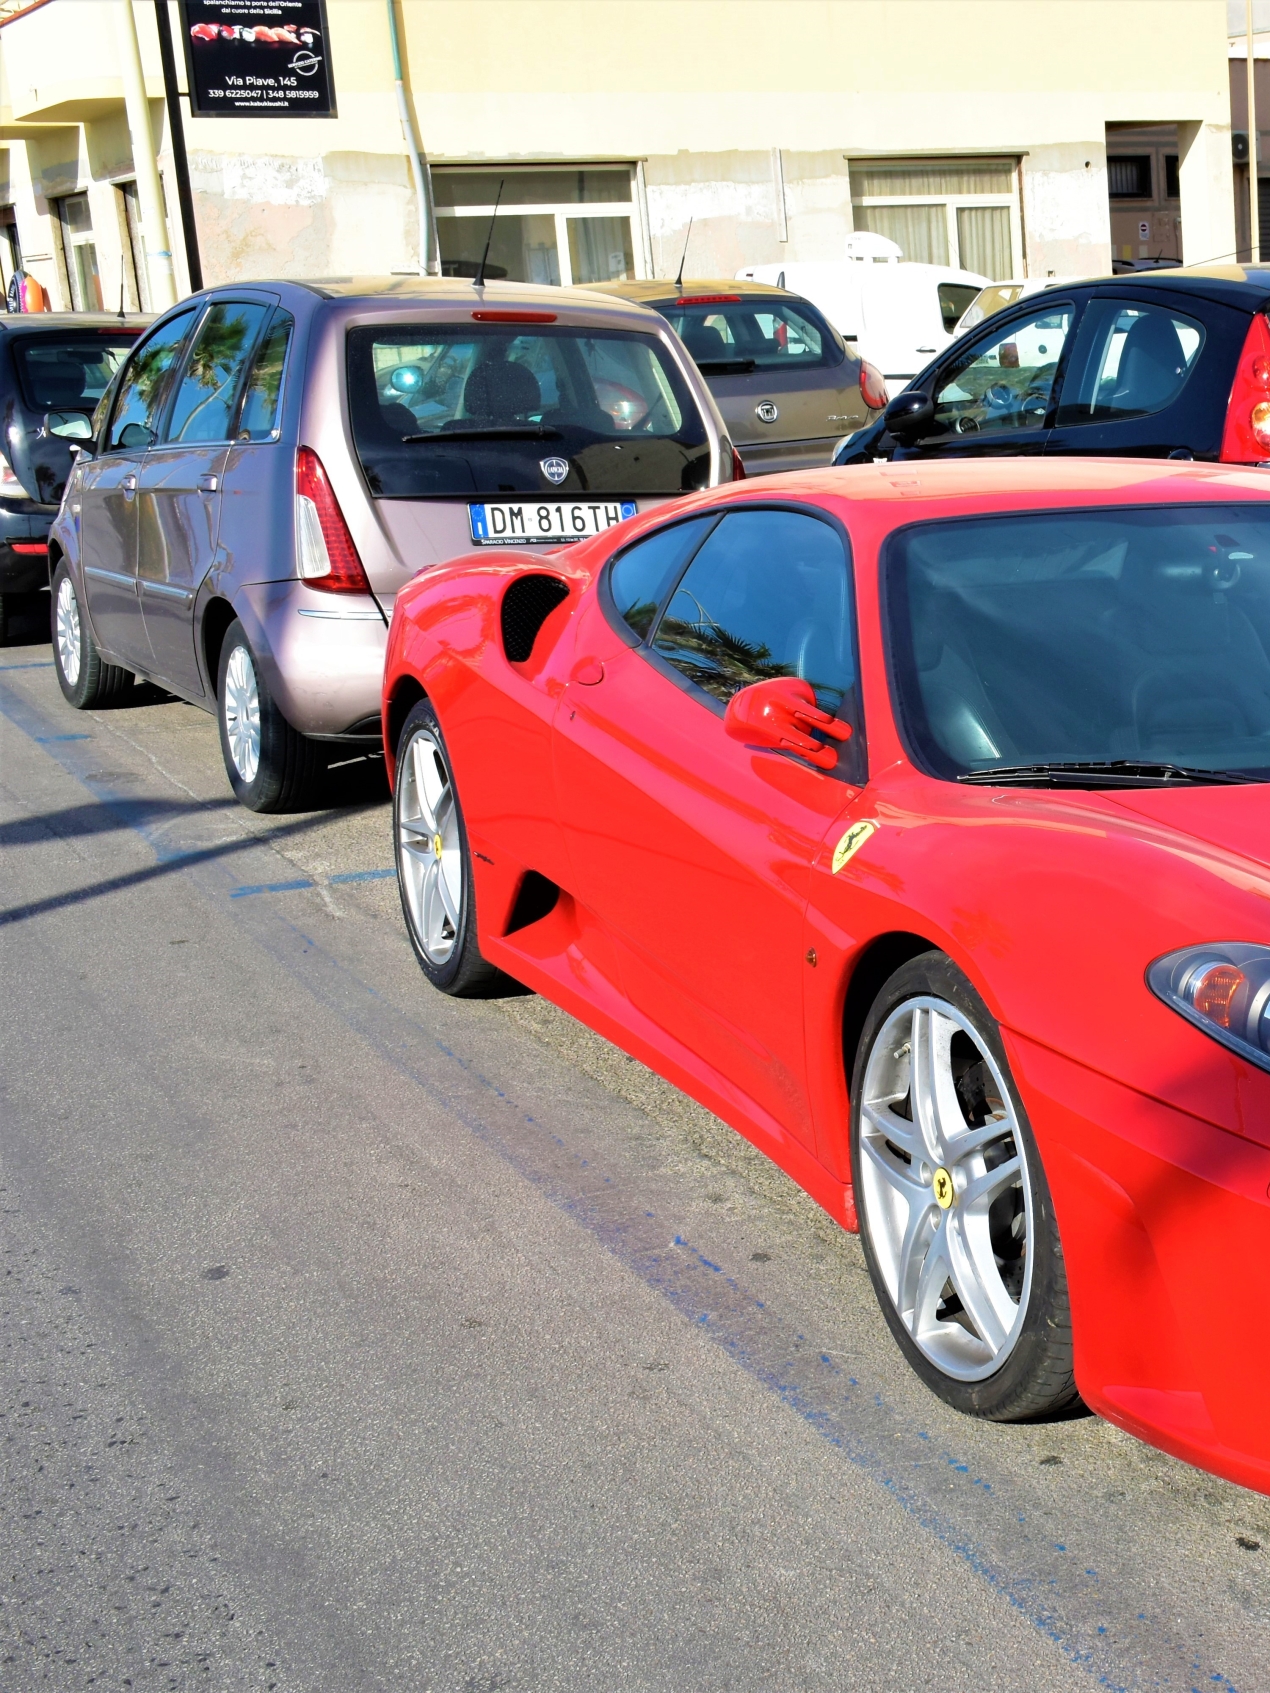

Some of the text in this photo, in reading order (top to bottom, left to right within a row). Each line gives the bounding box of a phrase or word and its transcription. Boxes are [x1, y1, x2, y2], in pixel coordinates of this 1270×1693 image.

[225, 76, 297, 87] Via Piave, 145
[208, 89, 224, 97] 339
[226, 90, 261, 98] 6225047
[268, 90, 284, 98] 348
[286, 90, 319, 98] 5815959
[490, 505, 621, 534] DM 816TH
